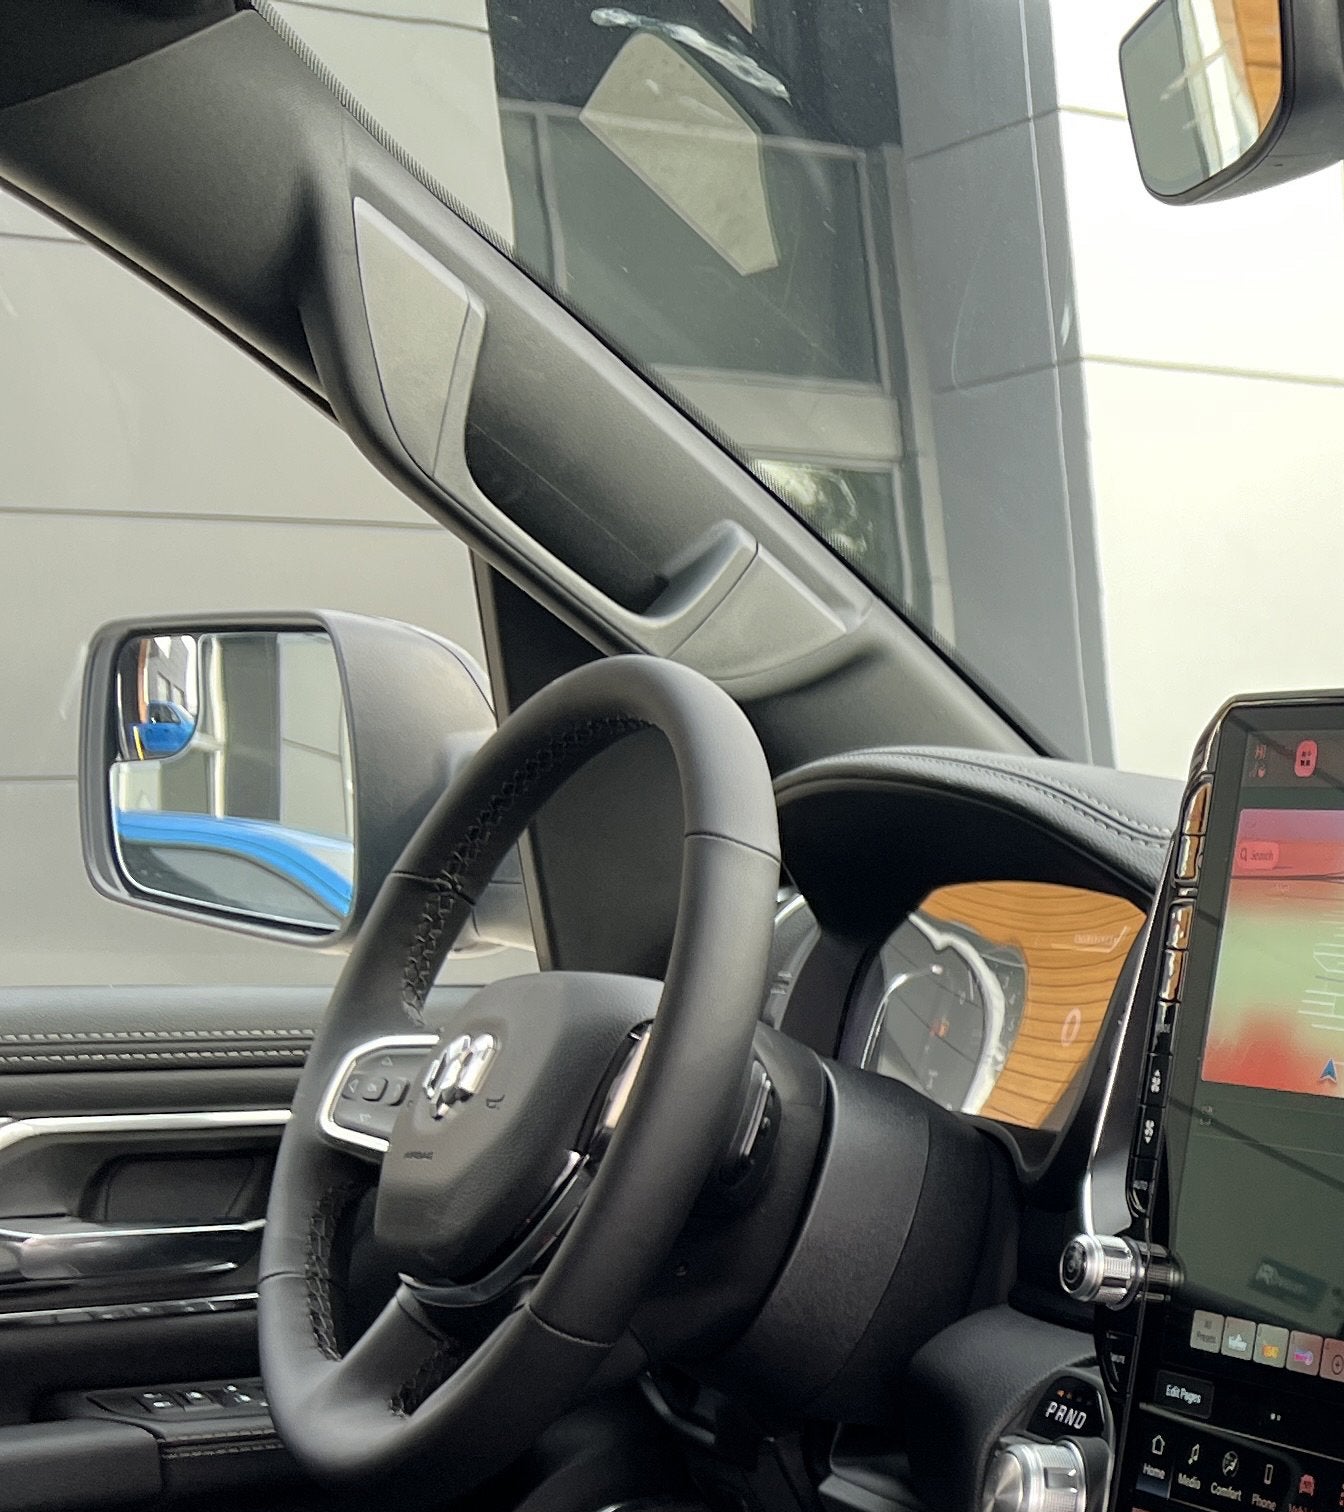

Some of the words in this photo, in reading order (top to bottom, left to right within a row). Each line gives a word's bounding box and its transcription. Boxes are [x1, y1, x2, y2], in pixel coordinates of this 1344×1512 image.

[1143, 1462, 1165, 1479] Home
[1211, 1482, 1242, 1501] Comfort
[1252, 1493, 1276, 1511] Phone
